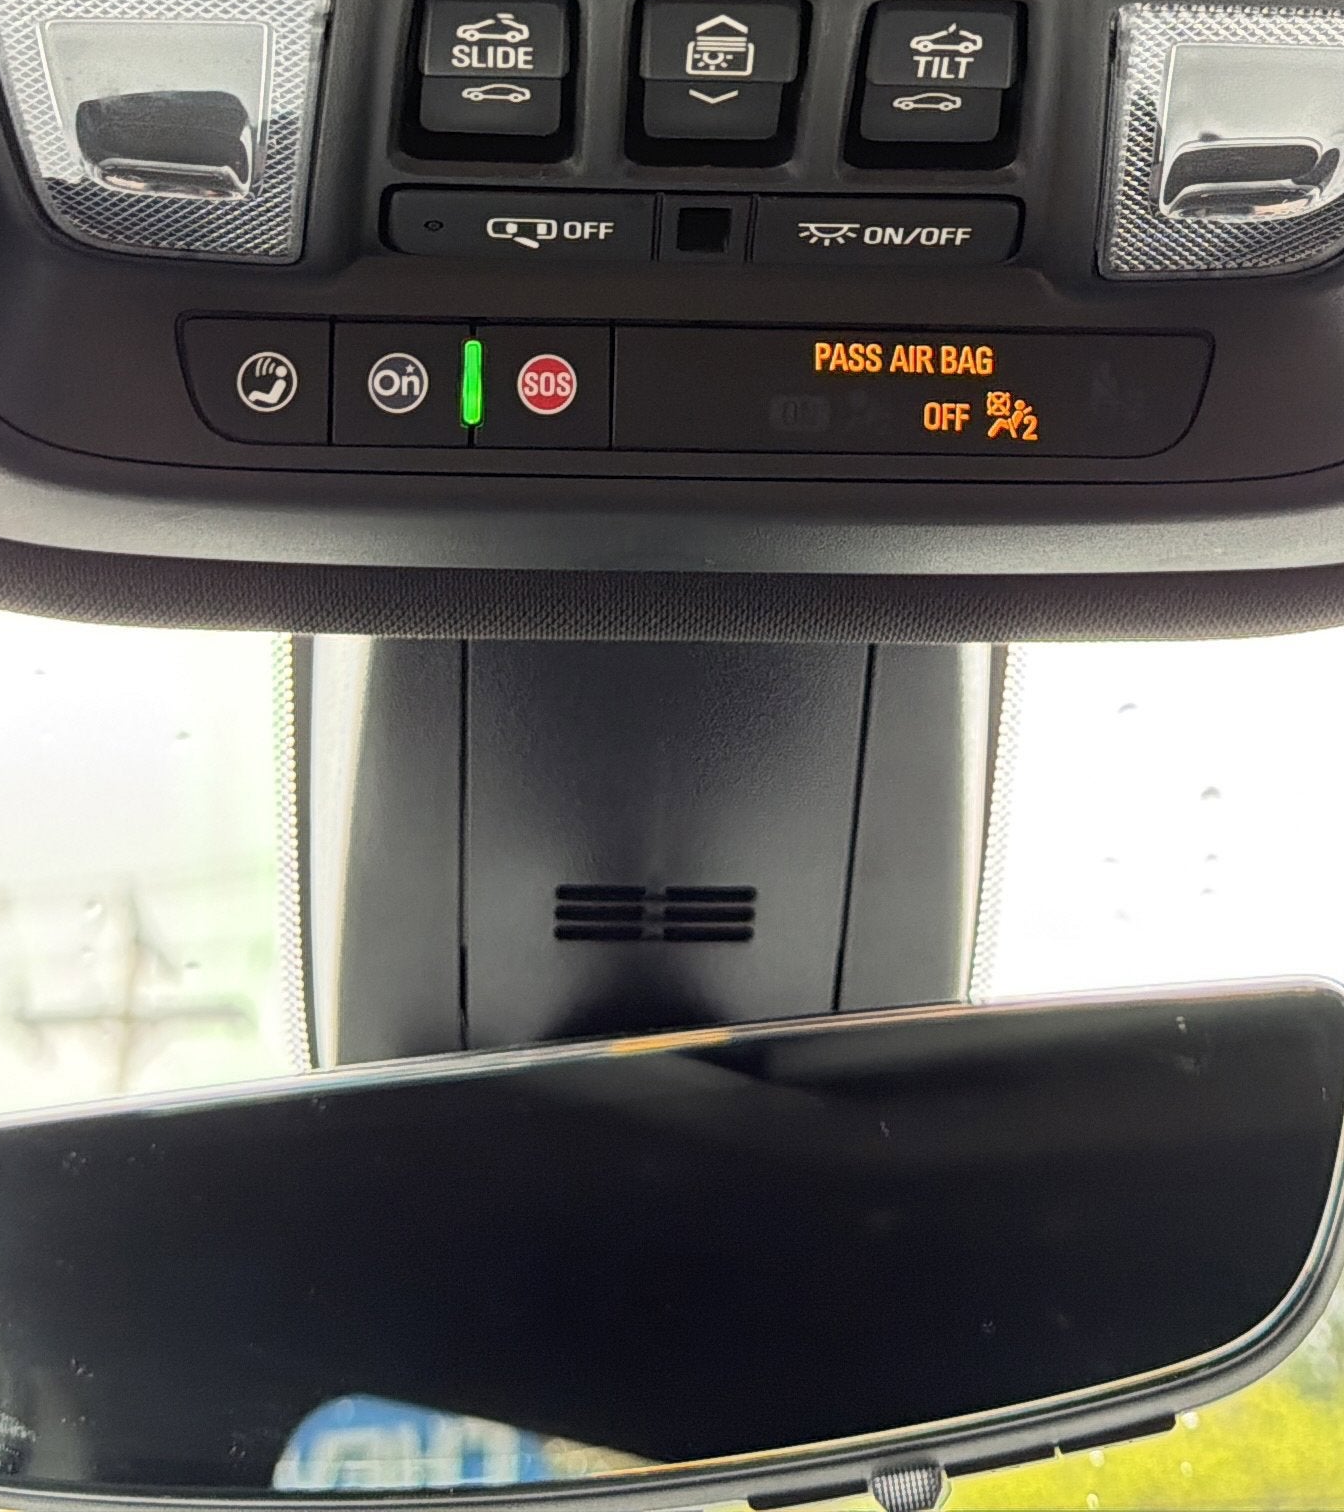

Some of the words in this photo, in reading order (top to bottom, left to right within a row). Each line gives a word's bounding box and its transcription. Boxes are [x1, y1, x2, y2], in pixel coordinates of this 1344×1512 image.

[451, 44, 534, 70] SLIDE
[913, 51, 975, 79] TILT
[563, 221, 614, 240] OFF
[863, 226, 972, 246] ON/OFF
[815, 342, 883, 373] PASS
[889, 345, 935, 374] AIR
[940, 346, 994, 375] BAG
[372, 370, 421, 397] On
[524, 370, 571, 398] SOS
[923, 401, 970, 431] OFF
[1022, 414, 1038, 441] 2
